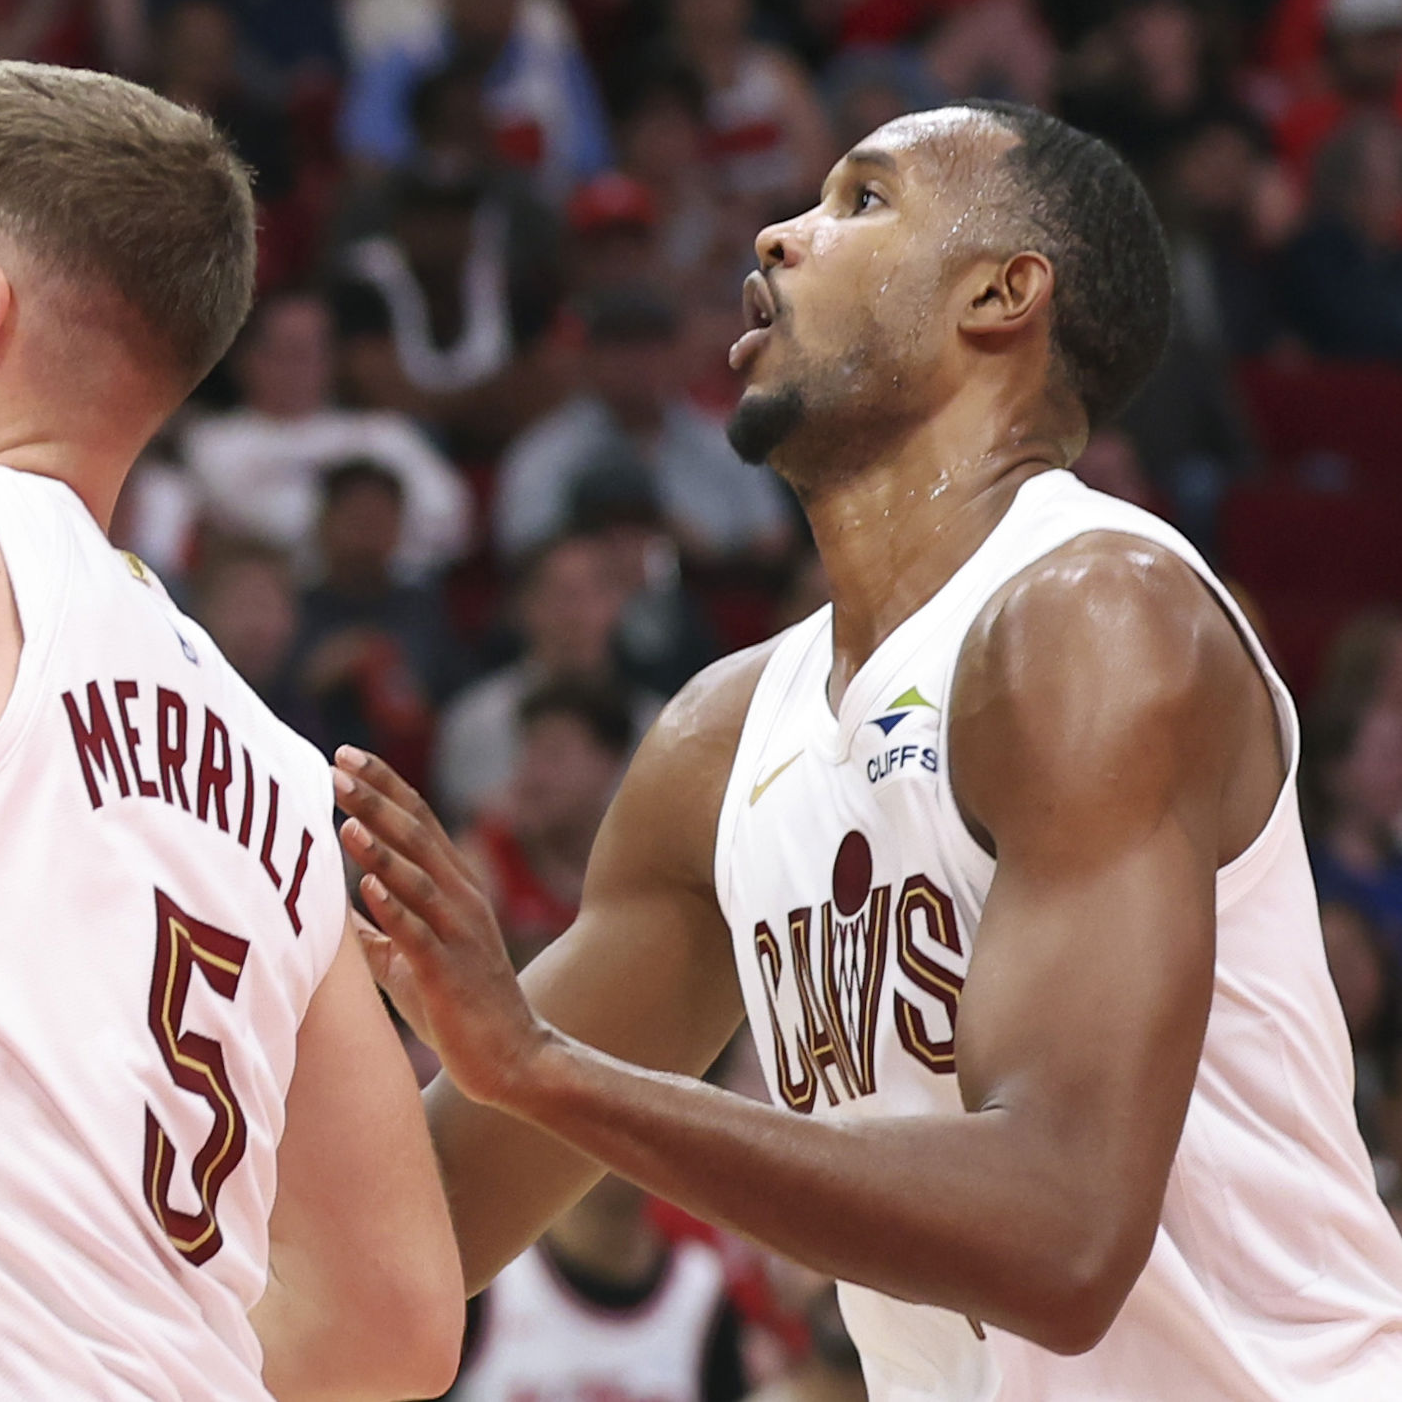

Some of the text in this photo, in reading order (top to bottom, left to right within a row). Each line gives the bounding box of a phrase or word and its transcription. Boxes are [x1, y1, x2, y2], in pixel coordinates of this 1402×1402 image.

[61, 679, 314, 938] MERRILL
[867, 745, 939, 784] CLIFFS
[142, 885, 251, 1268] 5
